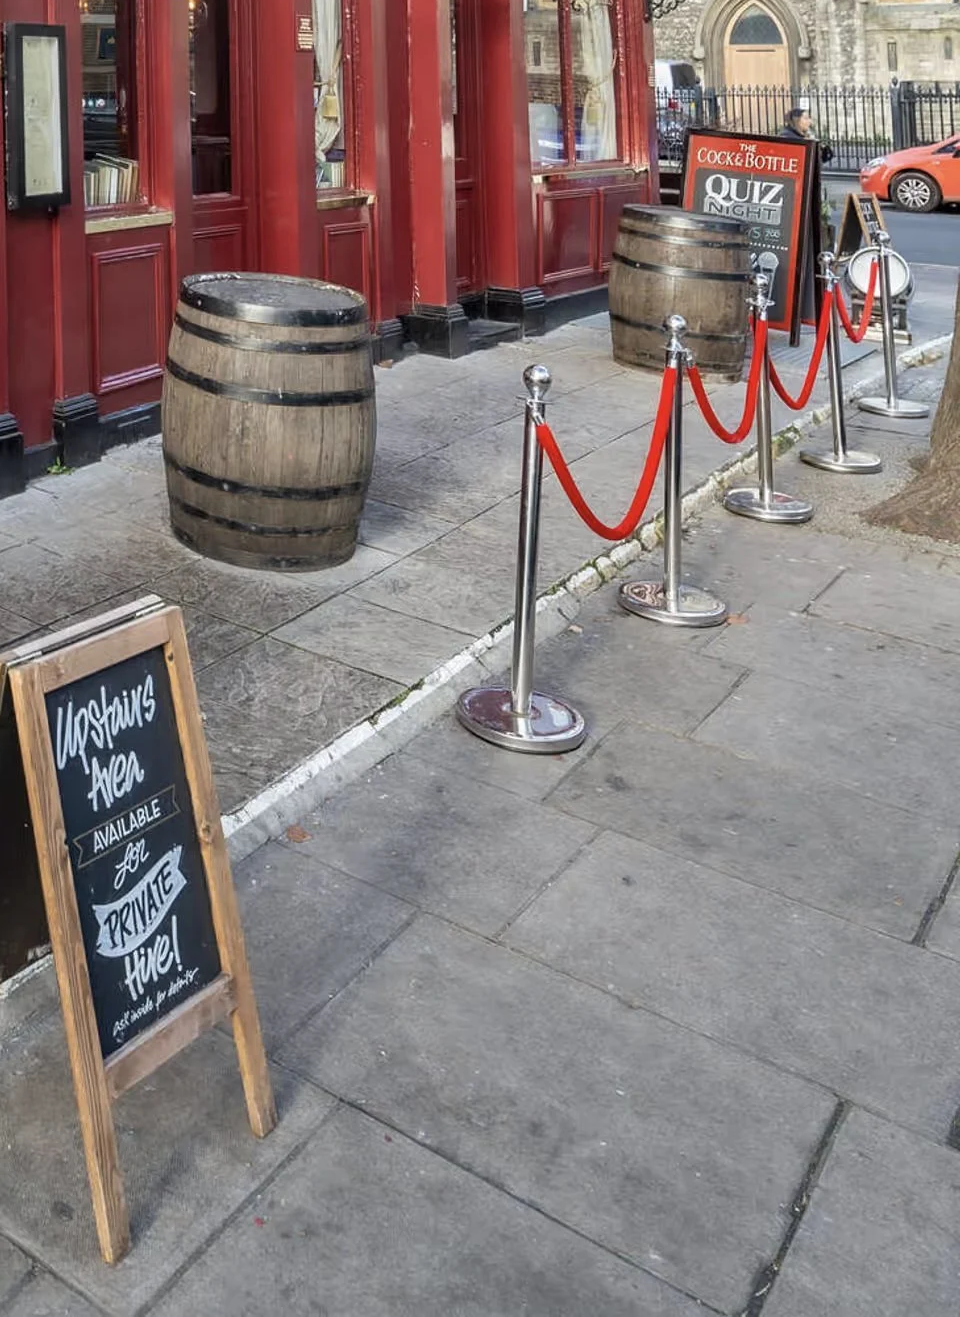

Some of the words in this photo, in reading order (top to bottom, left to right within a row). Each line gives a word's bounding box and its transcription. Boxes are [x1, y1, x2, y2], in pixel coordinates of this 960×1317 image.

[697, 147, 734, 167] COCK
[744, 151, 799, 174] BOTTLE
[739, 142, 758, 153] THE
[705, 173, 785, 207] QUIZ
[708, 203, 777, 221] NIGHT
[56, 674, 157, 775] Upstairs
[87, 750, 145, 812] Area
[93, 798, 162, 854] AVAILABLE
[113, 839, 150, 891] for
[102, 856, 174, 950] PRIVATE
[123, 914, 184, 1002] Hire!
